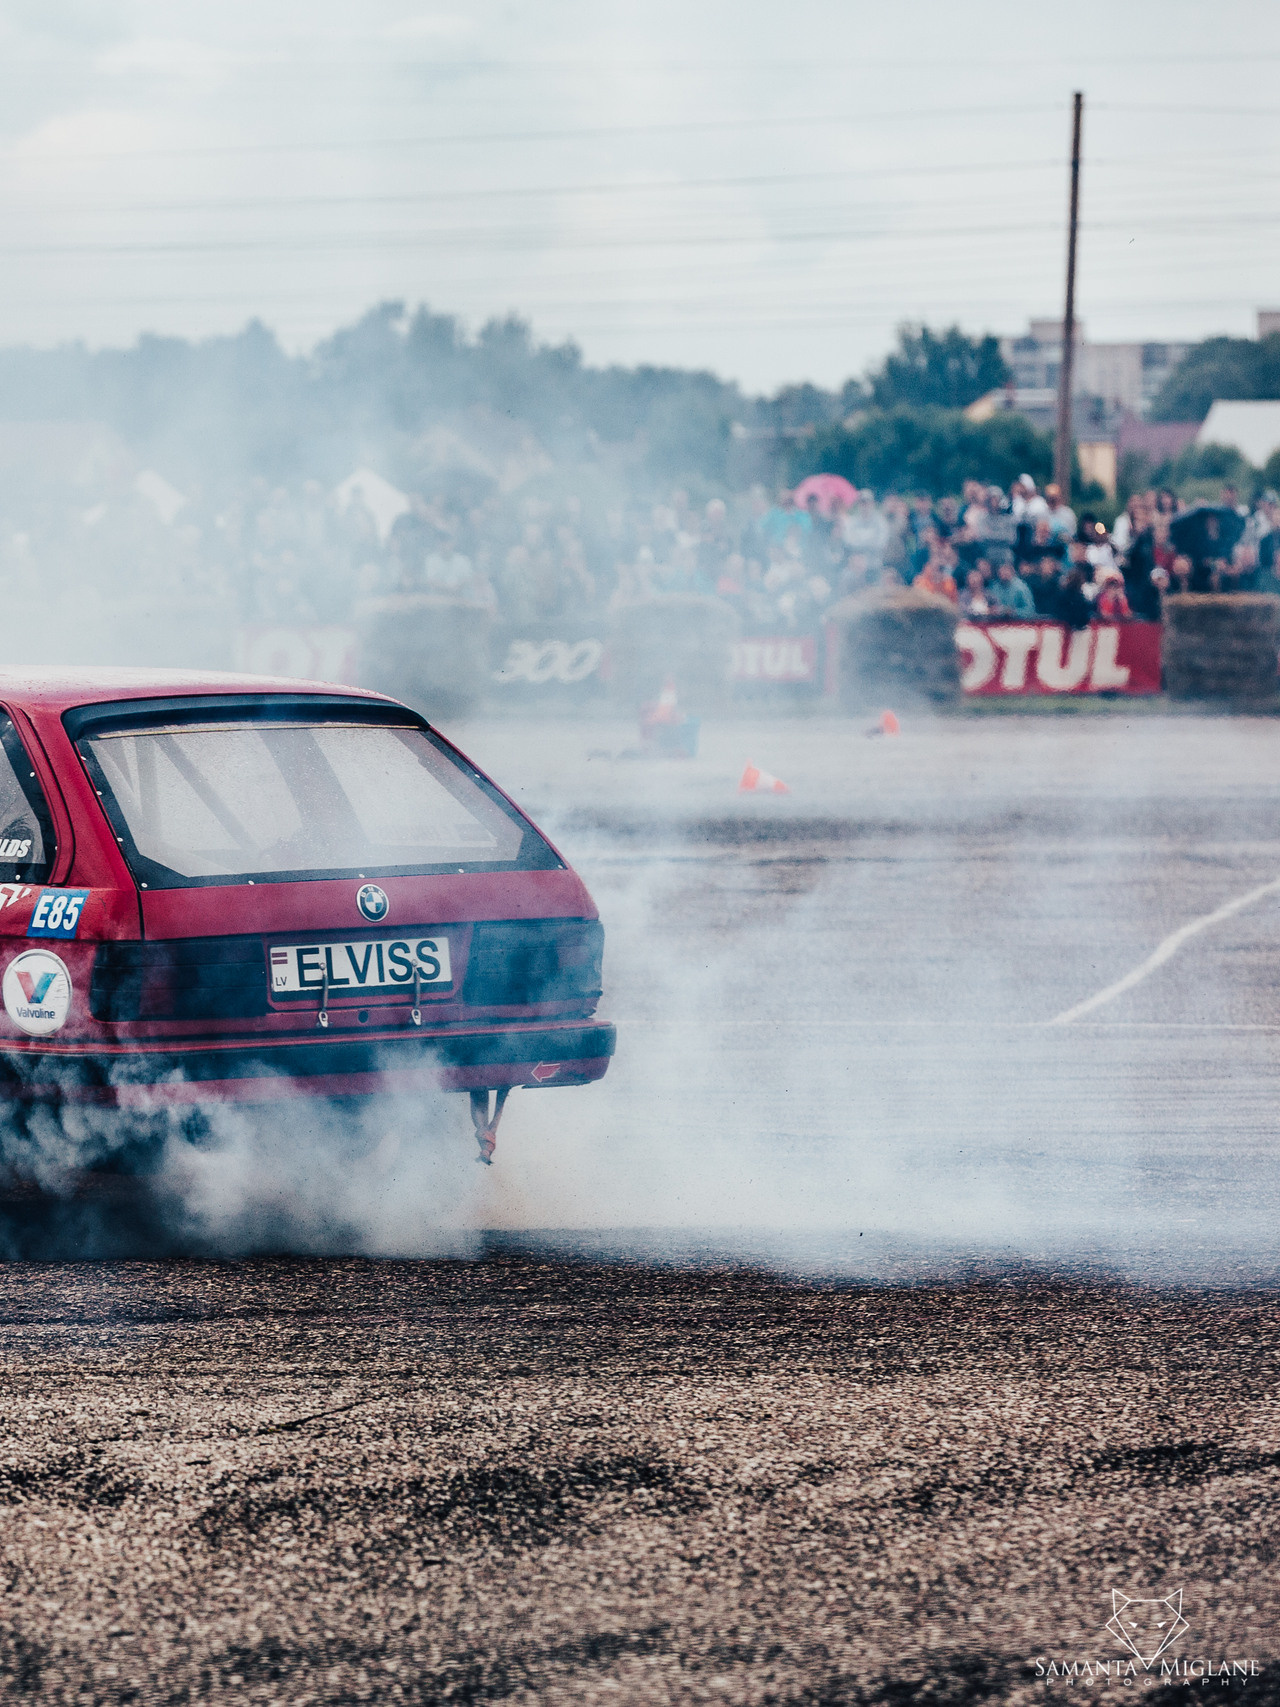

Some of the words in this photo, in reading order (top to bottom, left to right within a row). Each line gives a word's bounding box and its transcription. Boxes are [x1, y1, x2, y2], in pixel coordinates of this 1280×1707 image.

[32, 895, 85, 931] E85
[296, 940, 441, 988] ELVISS
[275, 976, 287, 987] LV
[16, 1006, 56, 1019] Valvoline
